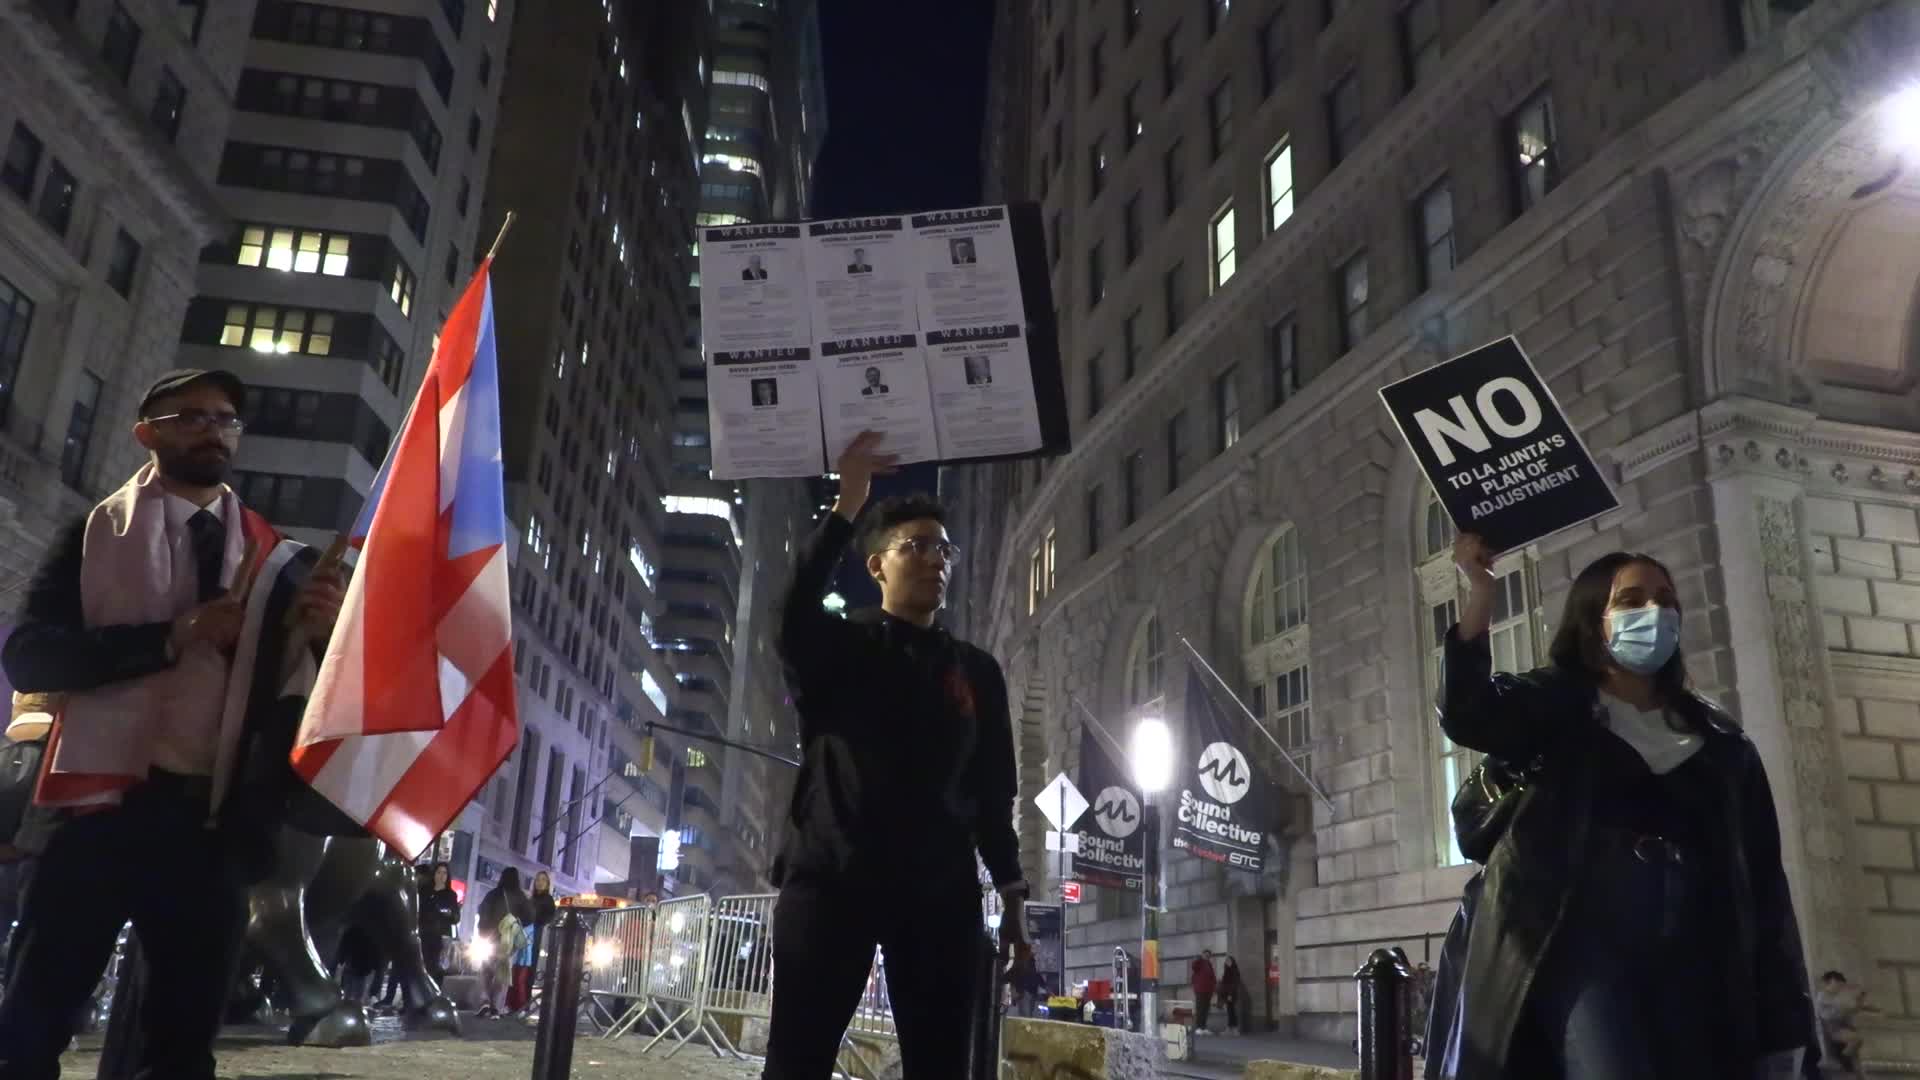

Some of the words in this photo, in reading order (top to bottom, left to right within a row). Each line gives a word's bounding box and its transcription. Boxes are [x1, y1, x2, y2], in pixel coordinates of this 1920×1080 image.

[824, 217, 888, 231] WANTED
[927, 208, 989, 222] WANTED
[721, 225, 785, 237] WANTED
[836, 335, 902, 349] WANTED
[942, 326, 1006, 338] WANTED
[729, 346, 796, 359] WANTED
[1413, 377, 1542, 466] NO
[1448, 472, 1472, 490] TO
[1472, 463, 1496, 481] LA
[1498, 434, 1566, 471] JUNTA'S
[1481, 466, 1527, 495] PLAN
[1526, 459, 1549, 476] OF
[1470, 465, 1581, 520] ADJUSTMENT
[1181, 790, 1231, 821] Sound
[1079, 831, 1125, 852] Sound
[1077, 844, 1143, 868] Collectiv
